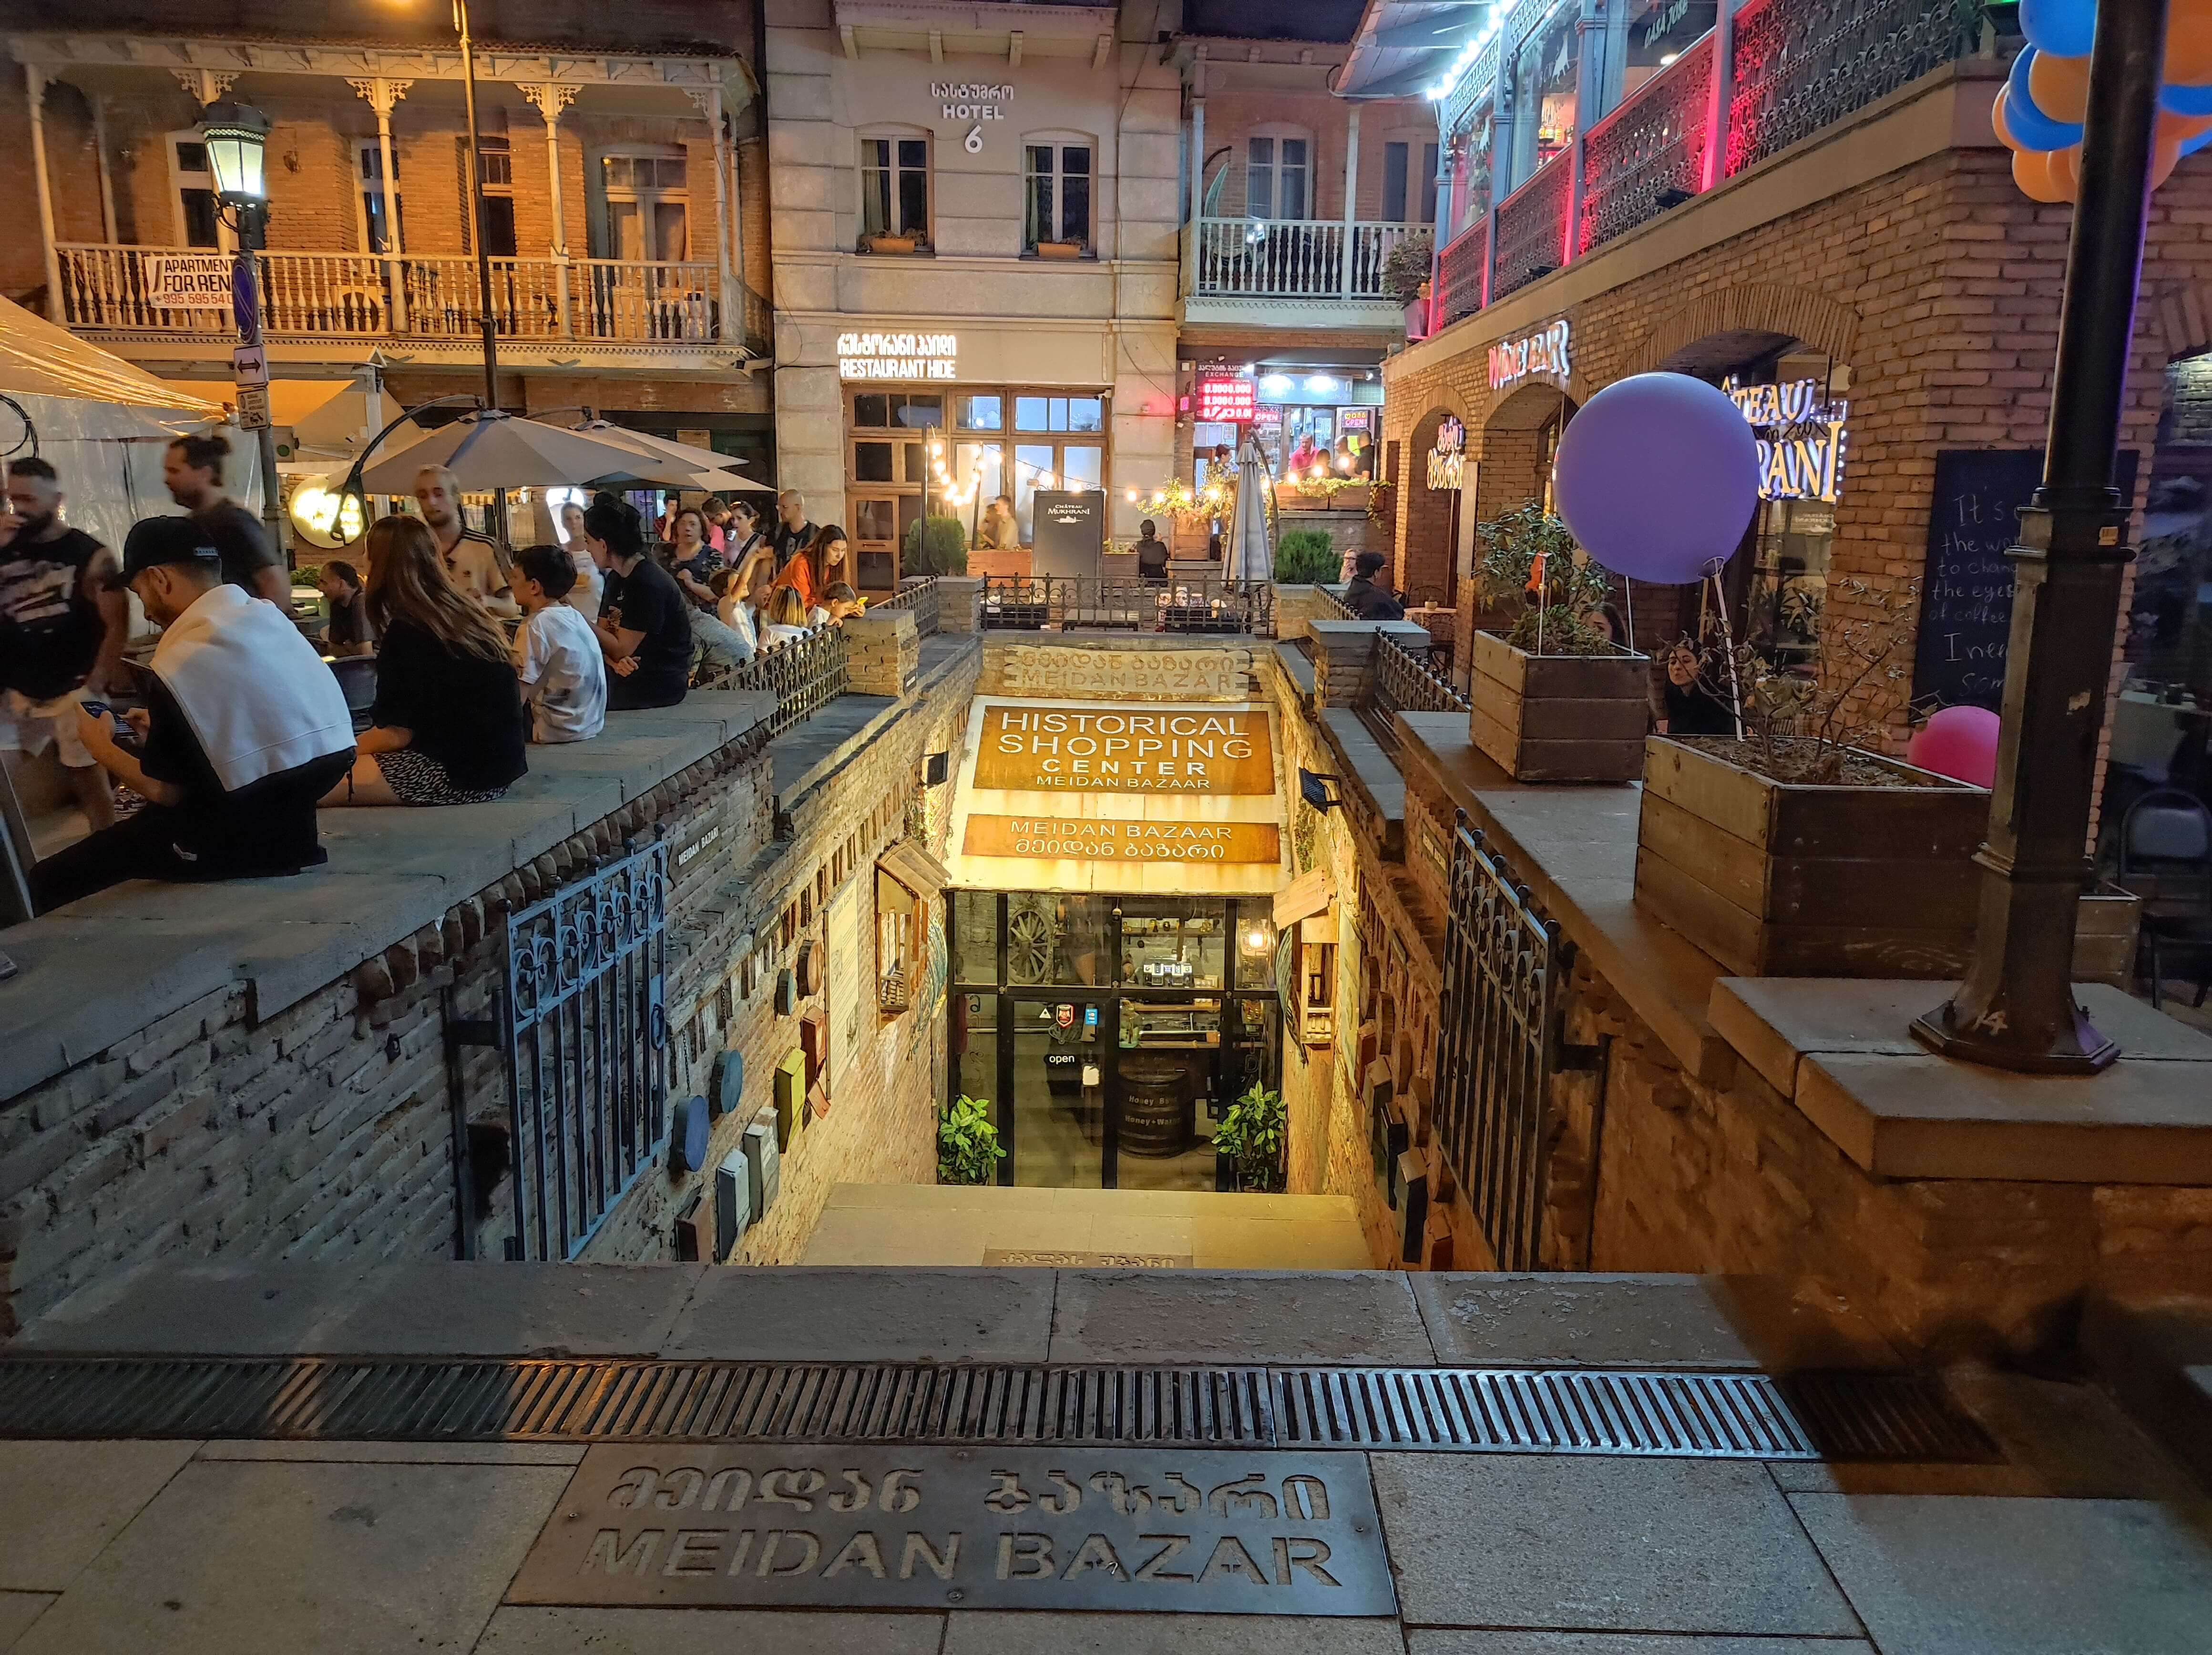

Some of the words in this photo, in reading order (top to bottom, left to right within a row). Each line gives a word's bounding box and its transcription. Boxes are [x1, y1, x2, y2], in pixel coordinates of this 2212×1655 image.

[931, 83, 1014, 100] სასტუმრო
[943, 104, 1004, 120] HOTEL
[964, 124, 983, 153] 6
[164, 275, 195, 292] FOR
[197, 275, 233, 292] REN
[155, 294, 184, 304] +995
[188, 294, 209, 304] 595
[211, 294, 225, 304] 54
[840, 358, 926, 378] RESTAURANT
[927, 359, 956, 378] HIDE
[1941, 531, 1978, 556] the
[1938, 556, 1960, 577] to
[1932, 580, 1965, 601] the
[1944, 633, 1962, 662] I
[1023, 669, 1126, 687] MEIDAN
[1134, 673, 1231, 694] BAZAR
[1002, 712, 1249, 736] HISTORICAL
[998, 734, 1252, 758] SHOPPING
[1042, 758, 1206, 776] CENTER
[1036, 775, 1119, 787] MEIDAN
[1127, 778, 1210, 789] BAZAAR
[1011, 821, 1116, 838] MEIDAN
[1126, 826, 1232, 839] BAZAAR
[678, 841, 699, 867] MEIDAN
[701, 826, 719, 849] BAZARI
[1015, 839, 1115, 856] მეიდან
[1125, 843, 1225, 858] ბაზარი
[1049, 1055, 1075, 1065] open
[607, 1466, 924, 1513] მეიდან
[984, 1469, 1330, 1520] ბაზარი
[577, 1528, 962, 1580] MEIDAN
[995, 1532, 1342, 1587] BAZAR
